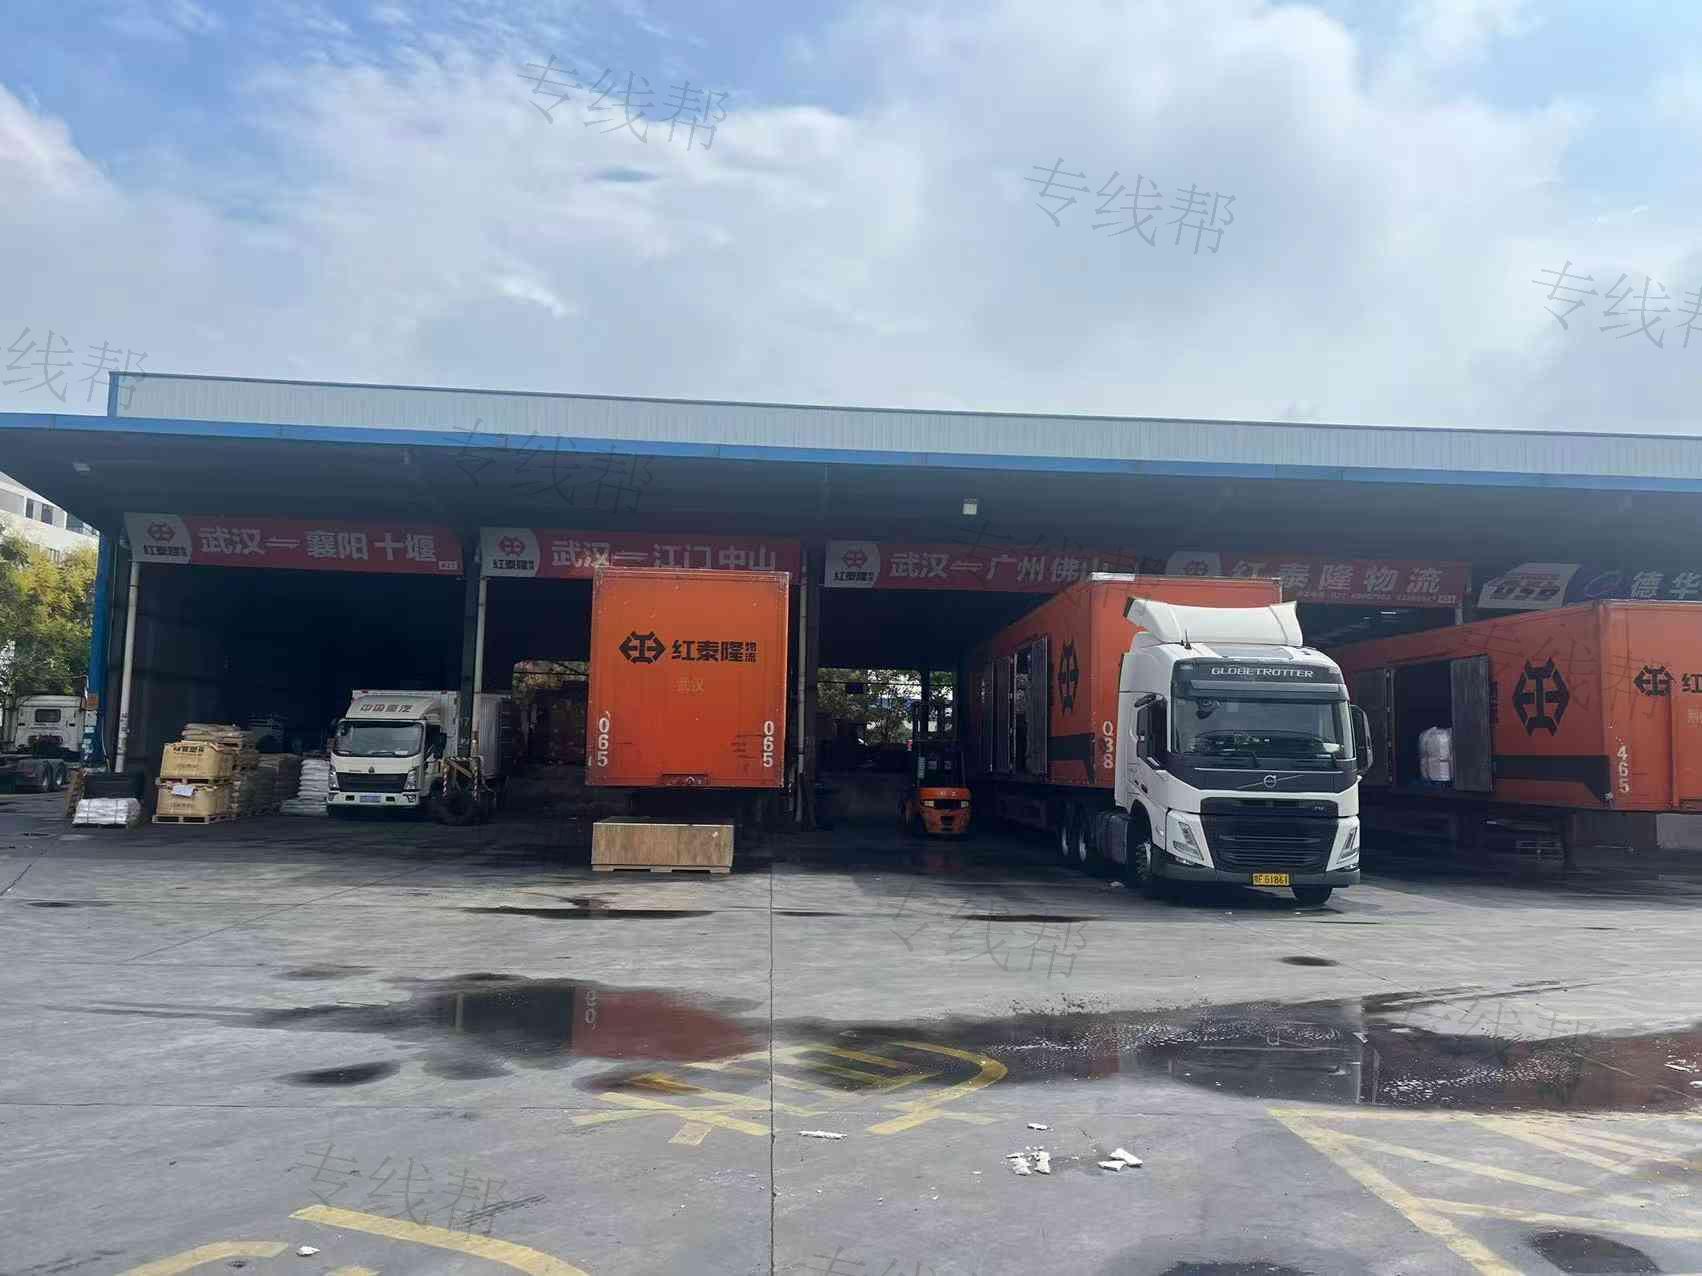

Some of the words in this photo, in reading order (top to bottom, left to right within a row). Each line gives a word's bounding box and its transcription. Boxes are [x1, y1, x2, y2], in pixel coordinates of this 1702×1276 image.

[1210, 665, 1314, 678] GLOBETROTTER
[597, 717, 610, 767] 065
[762, 720, 774, 768] 065
[1103, 720, 1114, 769] 038
[1616, 745, 1630, 793] 465
